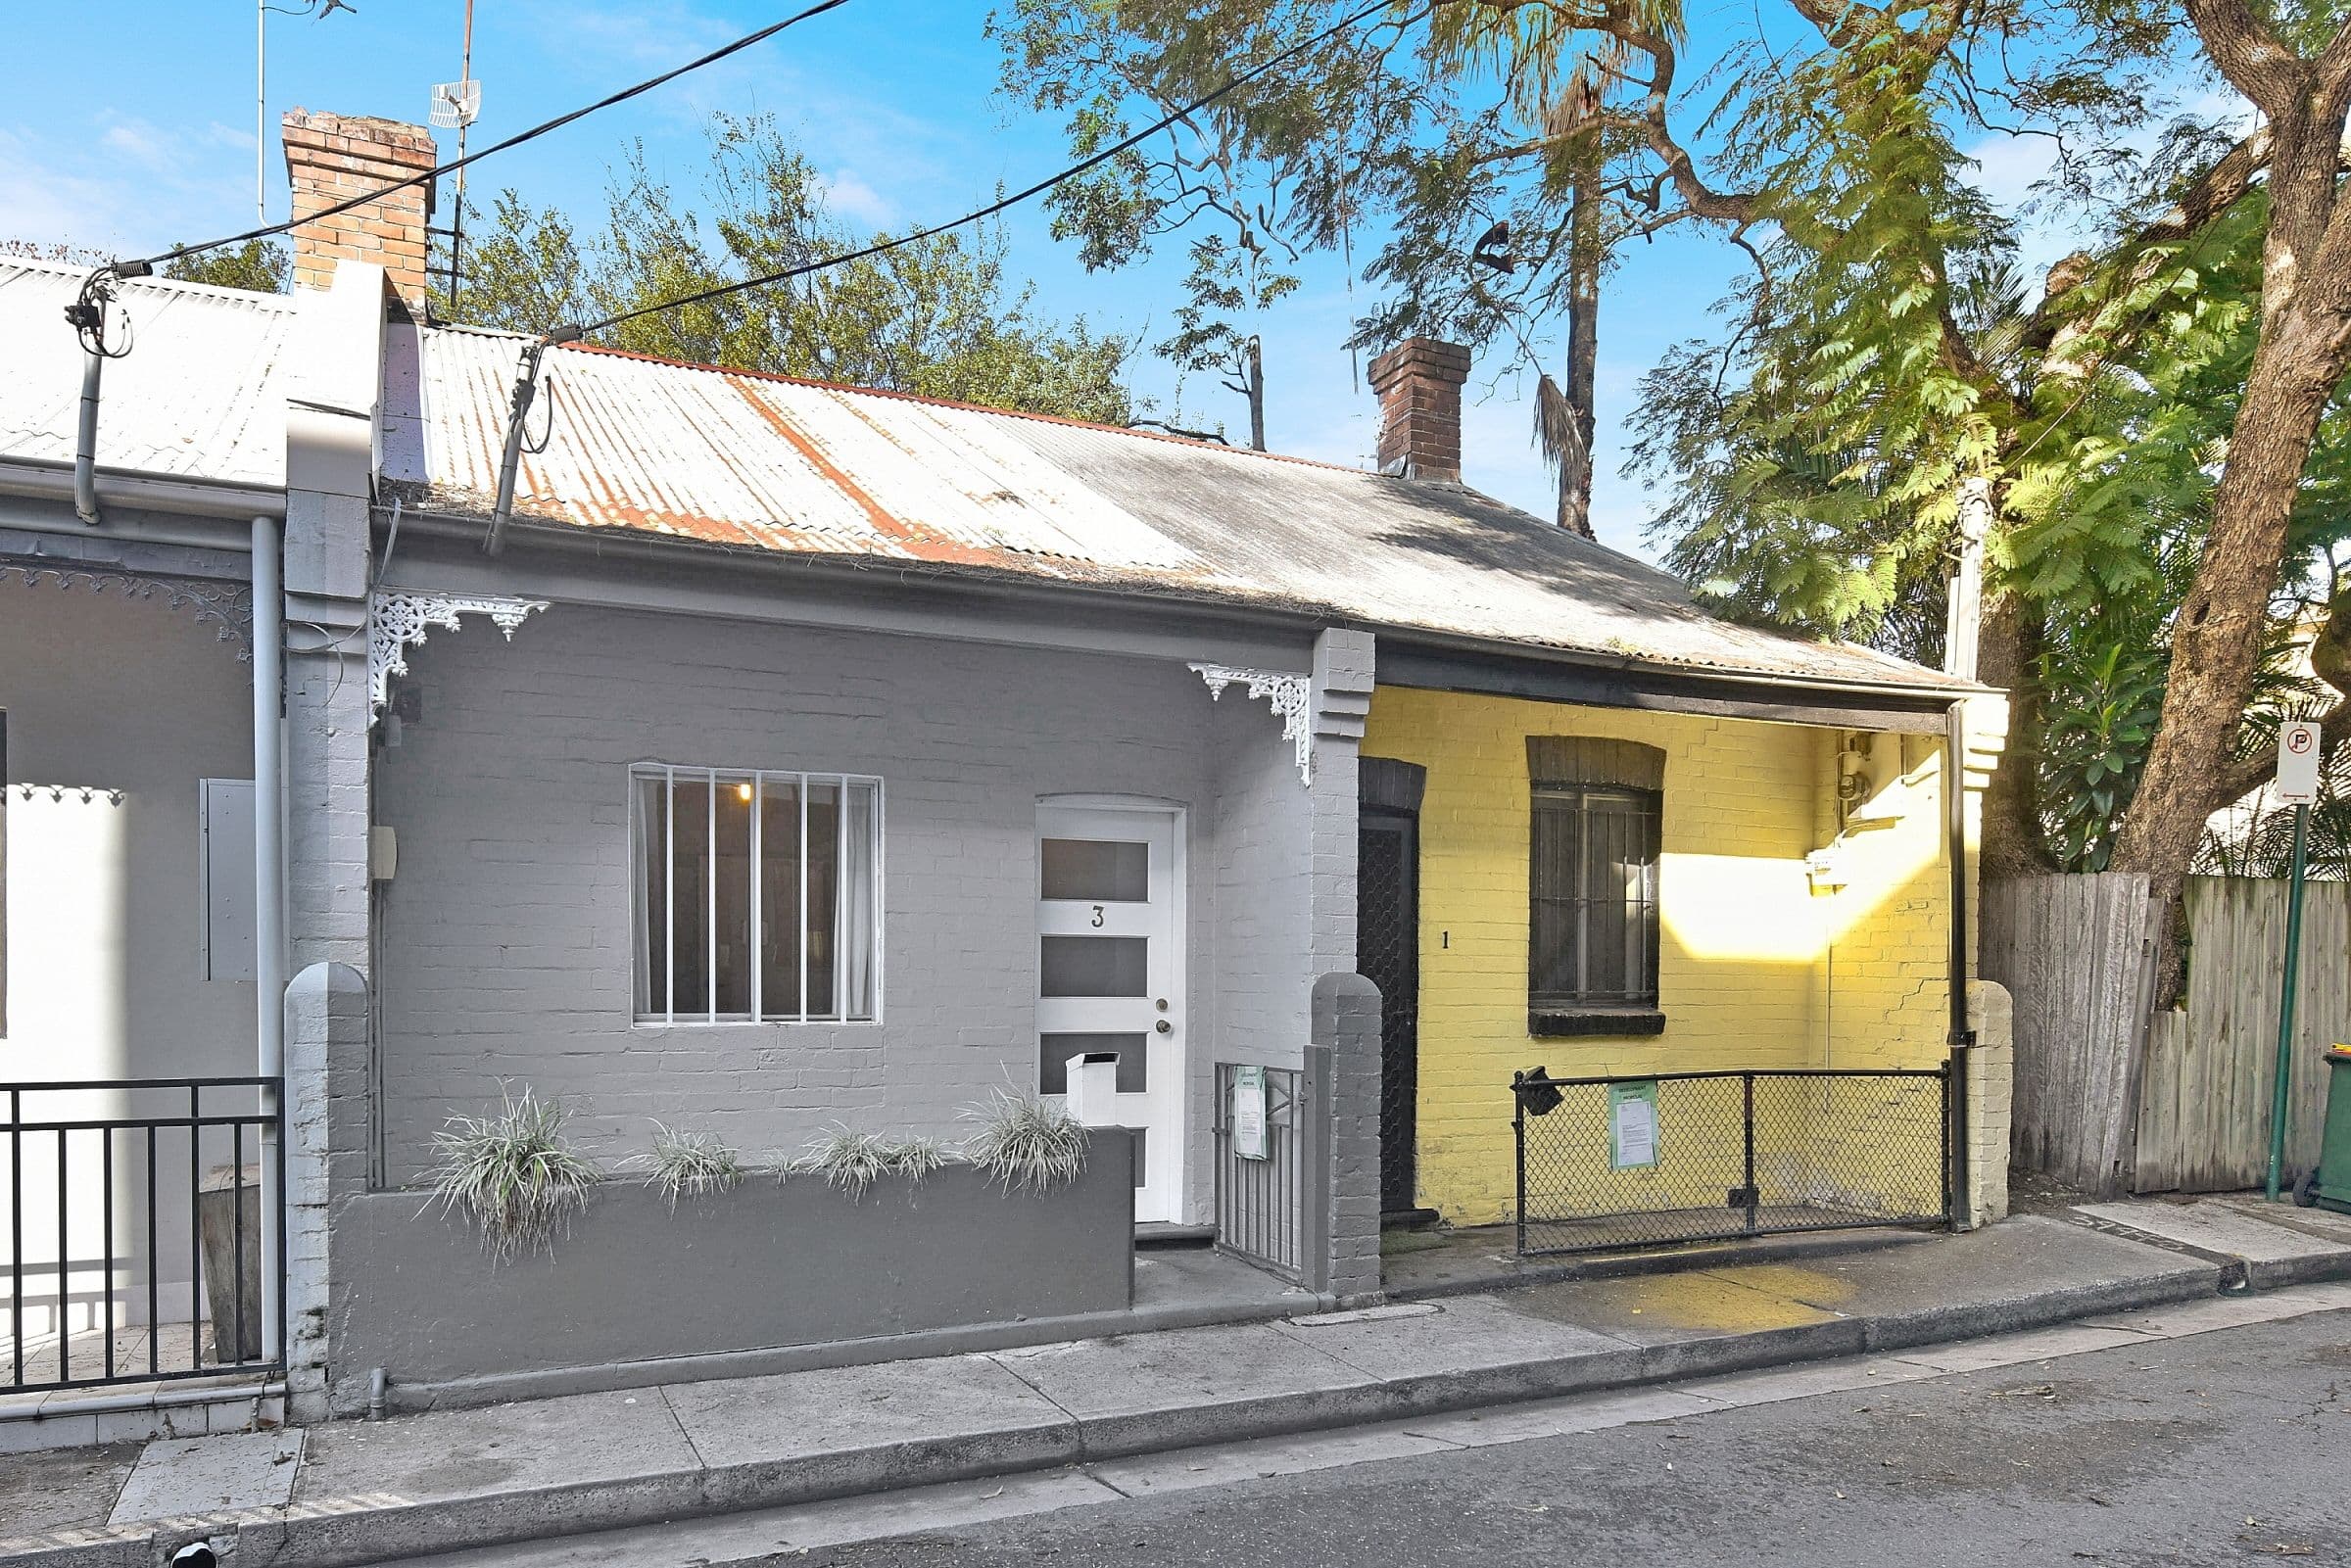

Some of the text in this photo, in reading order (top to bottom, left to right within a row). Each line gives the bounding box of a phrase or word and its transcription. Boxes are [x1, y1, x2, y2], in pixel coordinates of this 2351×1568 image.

[2295, 734, 2307, 749] P
[1091, 905, 1105, 927] 3
[1442, 930, 1450, 949] 1
